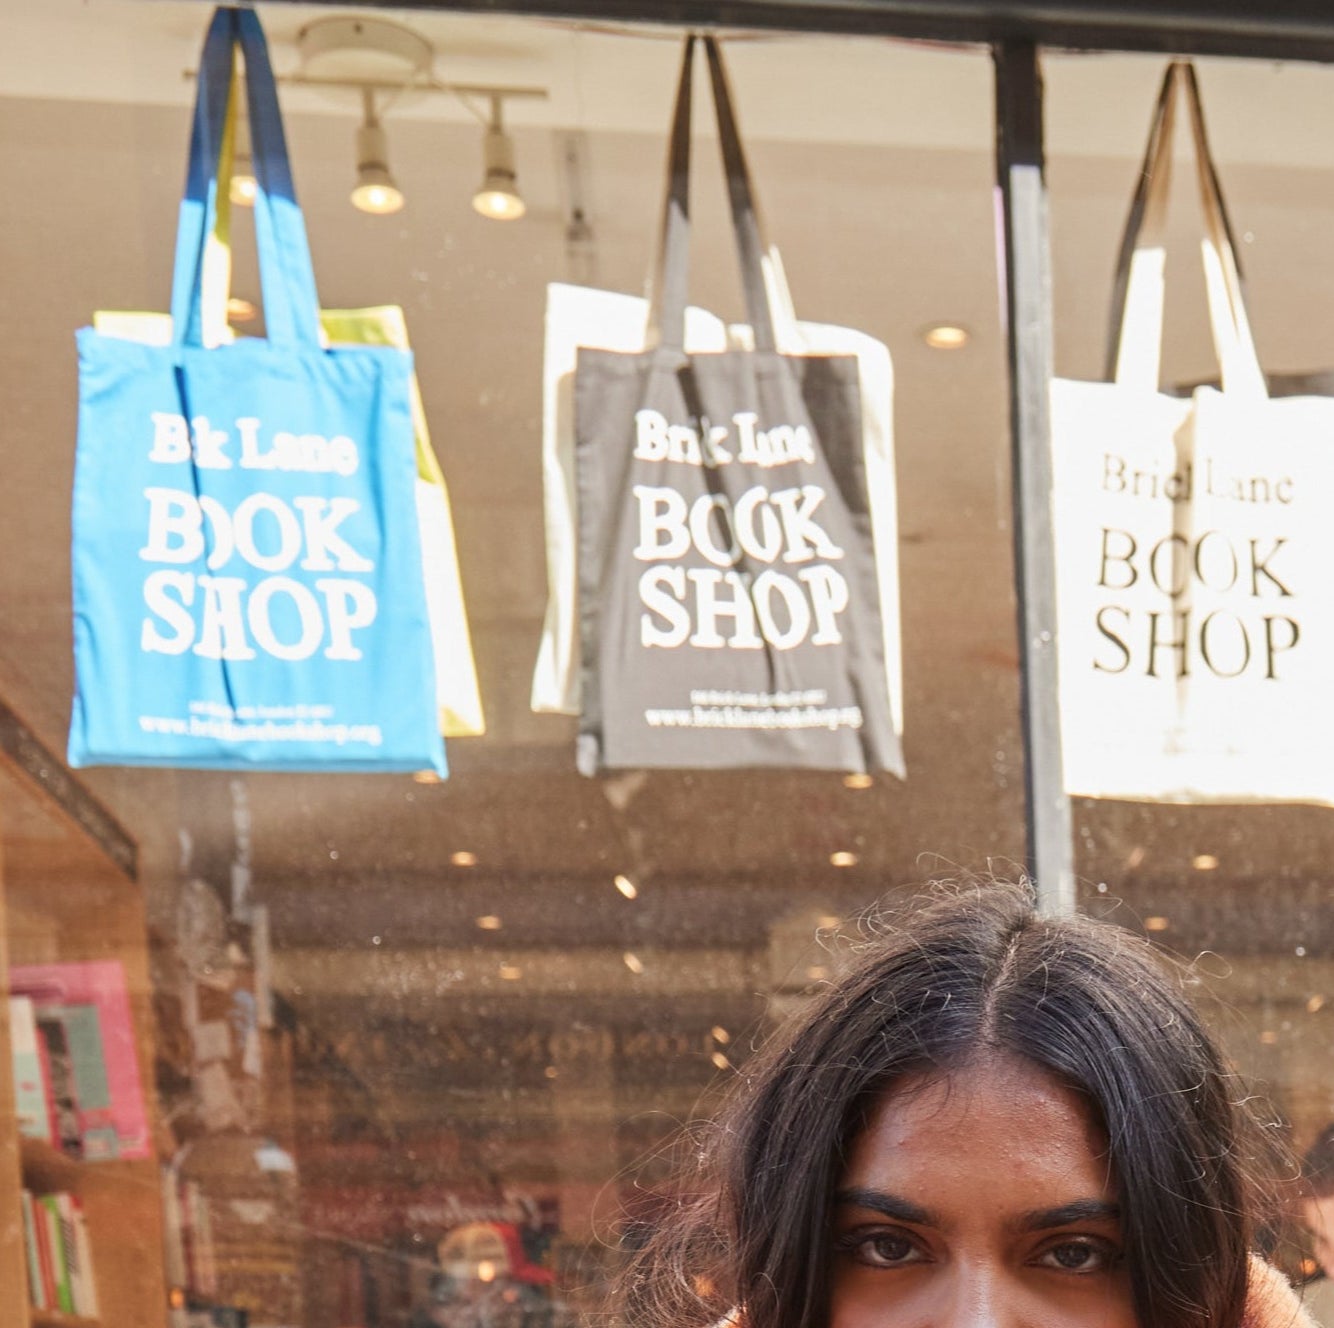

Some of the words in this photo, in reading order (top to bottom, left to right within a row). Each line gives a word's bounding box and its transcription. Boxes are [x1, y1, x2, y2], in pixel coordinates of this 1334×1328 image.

[634, 409, 731, 467] Brik
[633, 485, 844, 567] BOOK
[1097, 528, 1293, 599] BOOK
[141, 569, 377, 660] SHOP
[639, 565, 848, 650] SHOP
[1093, 606, 1300, 680] SHOP
